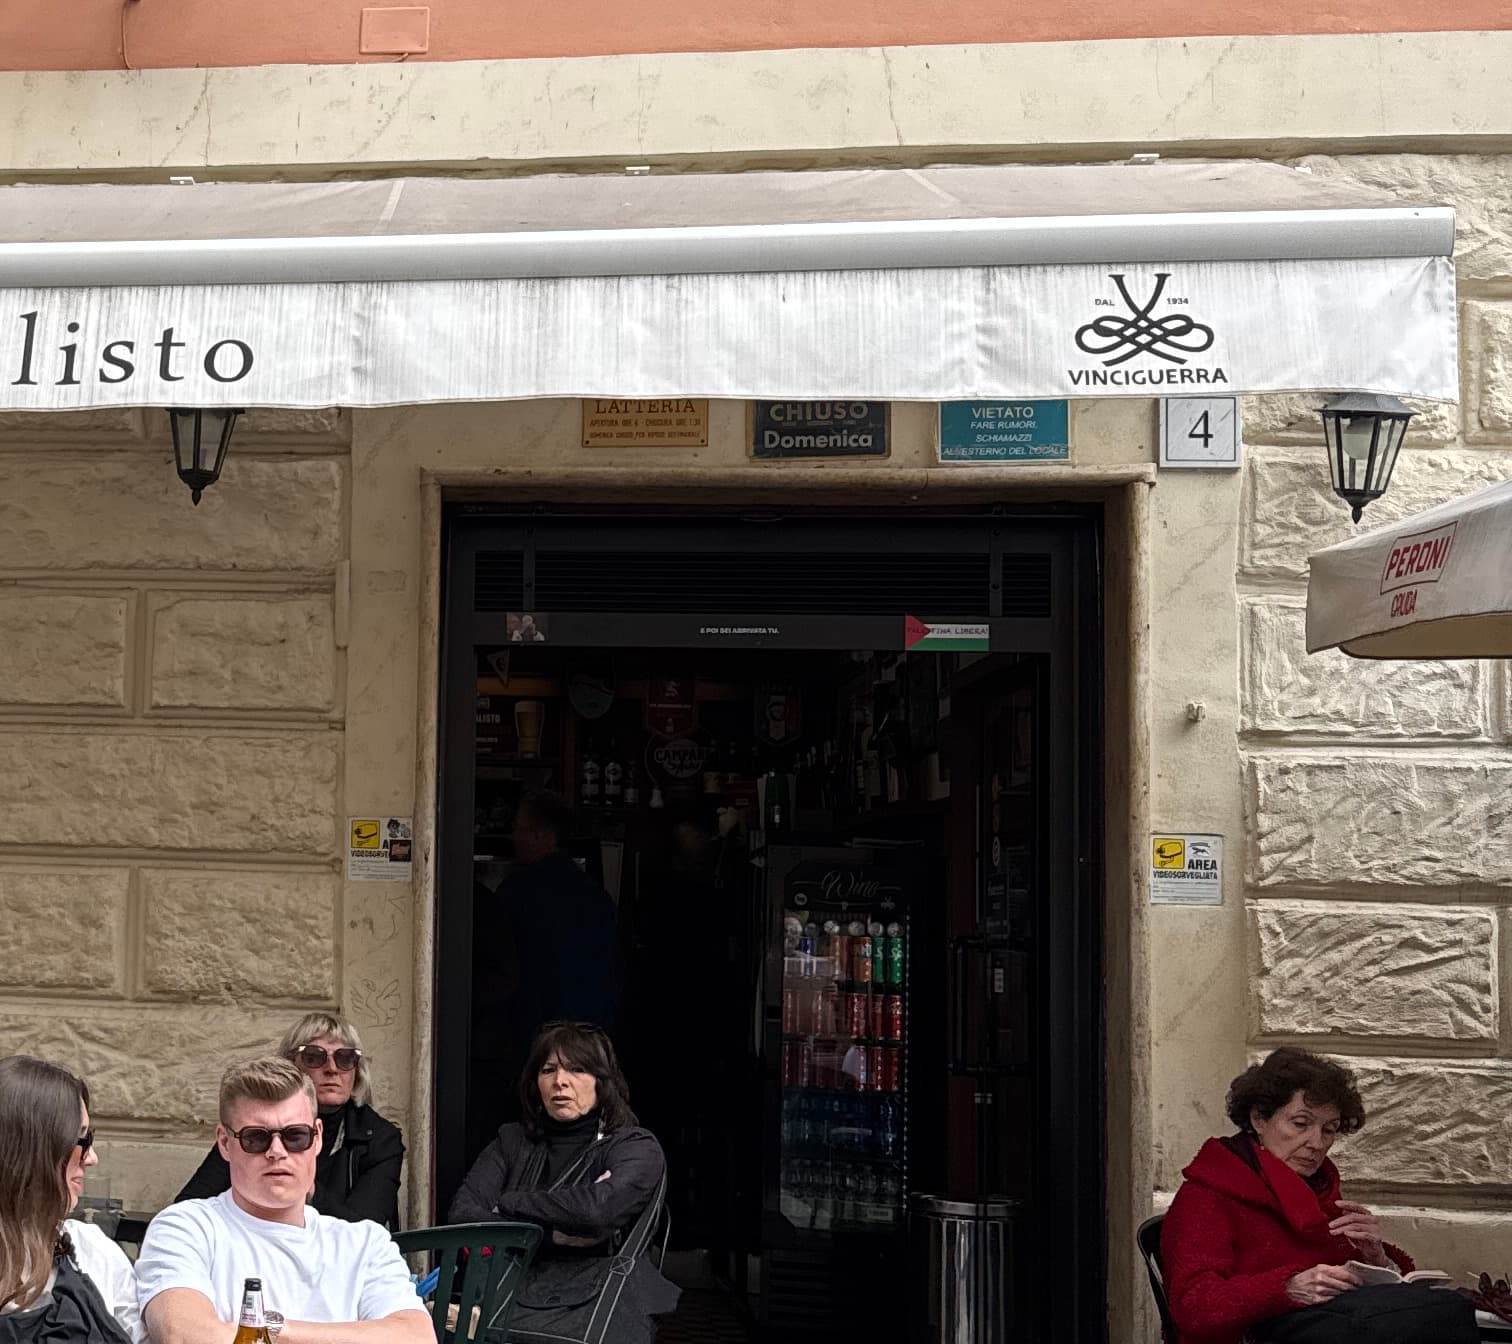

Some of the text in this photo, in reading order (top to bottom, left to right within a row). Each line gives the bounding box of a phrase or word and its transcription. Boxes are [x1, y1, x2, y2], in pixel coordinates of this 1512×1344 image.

[1094, 298, 1115, 306] DAL
[1166, 297, 1189, 305] 1934
[1068, 368, 1228, 386] VINCIGUERRA
[595, 399, 696, 414] LATTERIA
[769, 402, 868, 421] CHIUSO
[972, 407, 1034, 418] VIETATO
[970, 421, 995, 430] FARE
[1188, 410, 1214, 449] 4
[763, 429, 873, 449] Domenica
[976, 434, 1033, 443] SCHIAMAZZI
[943, 447, 1007, 456] ALESTERNO
[1009, 447, 1026, 455] DEL
[1385, 536, 1451, 581] PERONI
[1188, 859, 1218, 870] AREA
